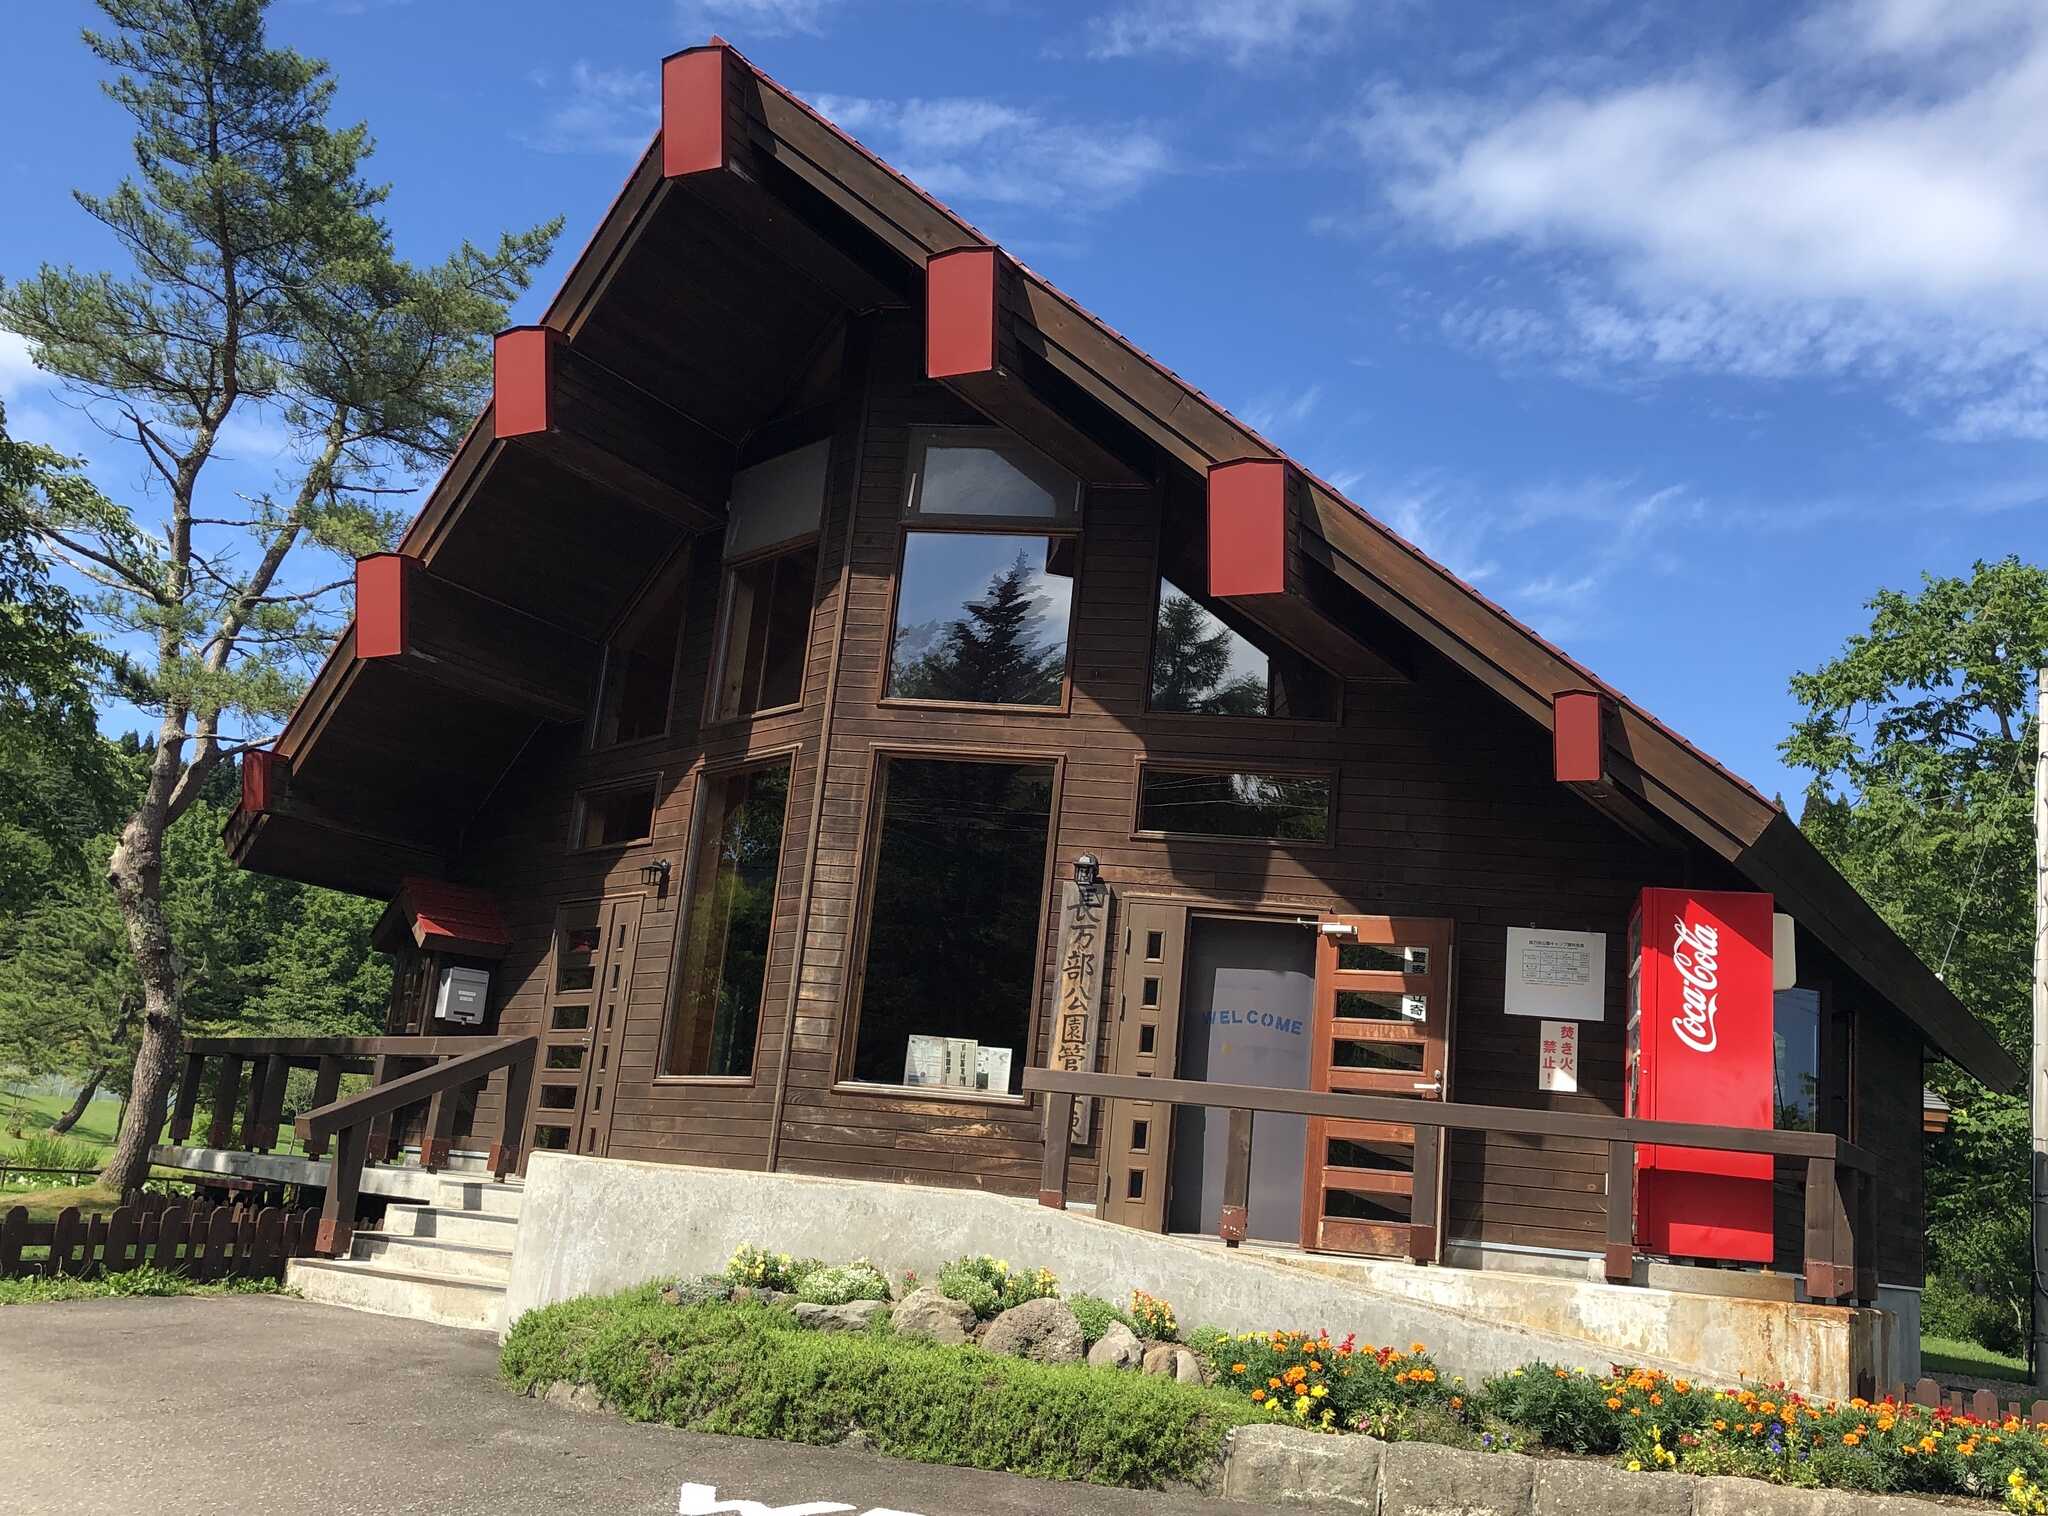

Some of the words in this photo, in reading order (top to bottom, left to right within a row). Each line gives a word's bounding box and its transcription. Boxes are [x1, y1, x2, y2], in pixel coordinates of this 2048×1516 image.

[1057, 886, 1102, 1138] 長万部公園管
[1201, 1009, 1303, 1035] WELCOME
[1672, 914, 1718, 1053] Coca-Cola
[1560, 1025, 1575, 1071] 焚き火
